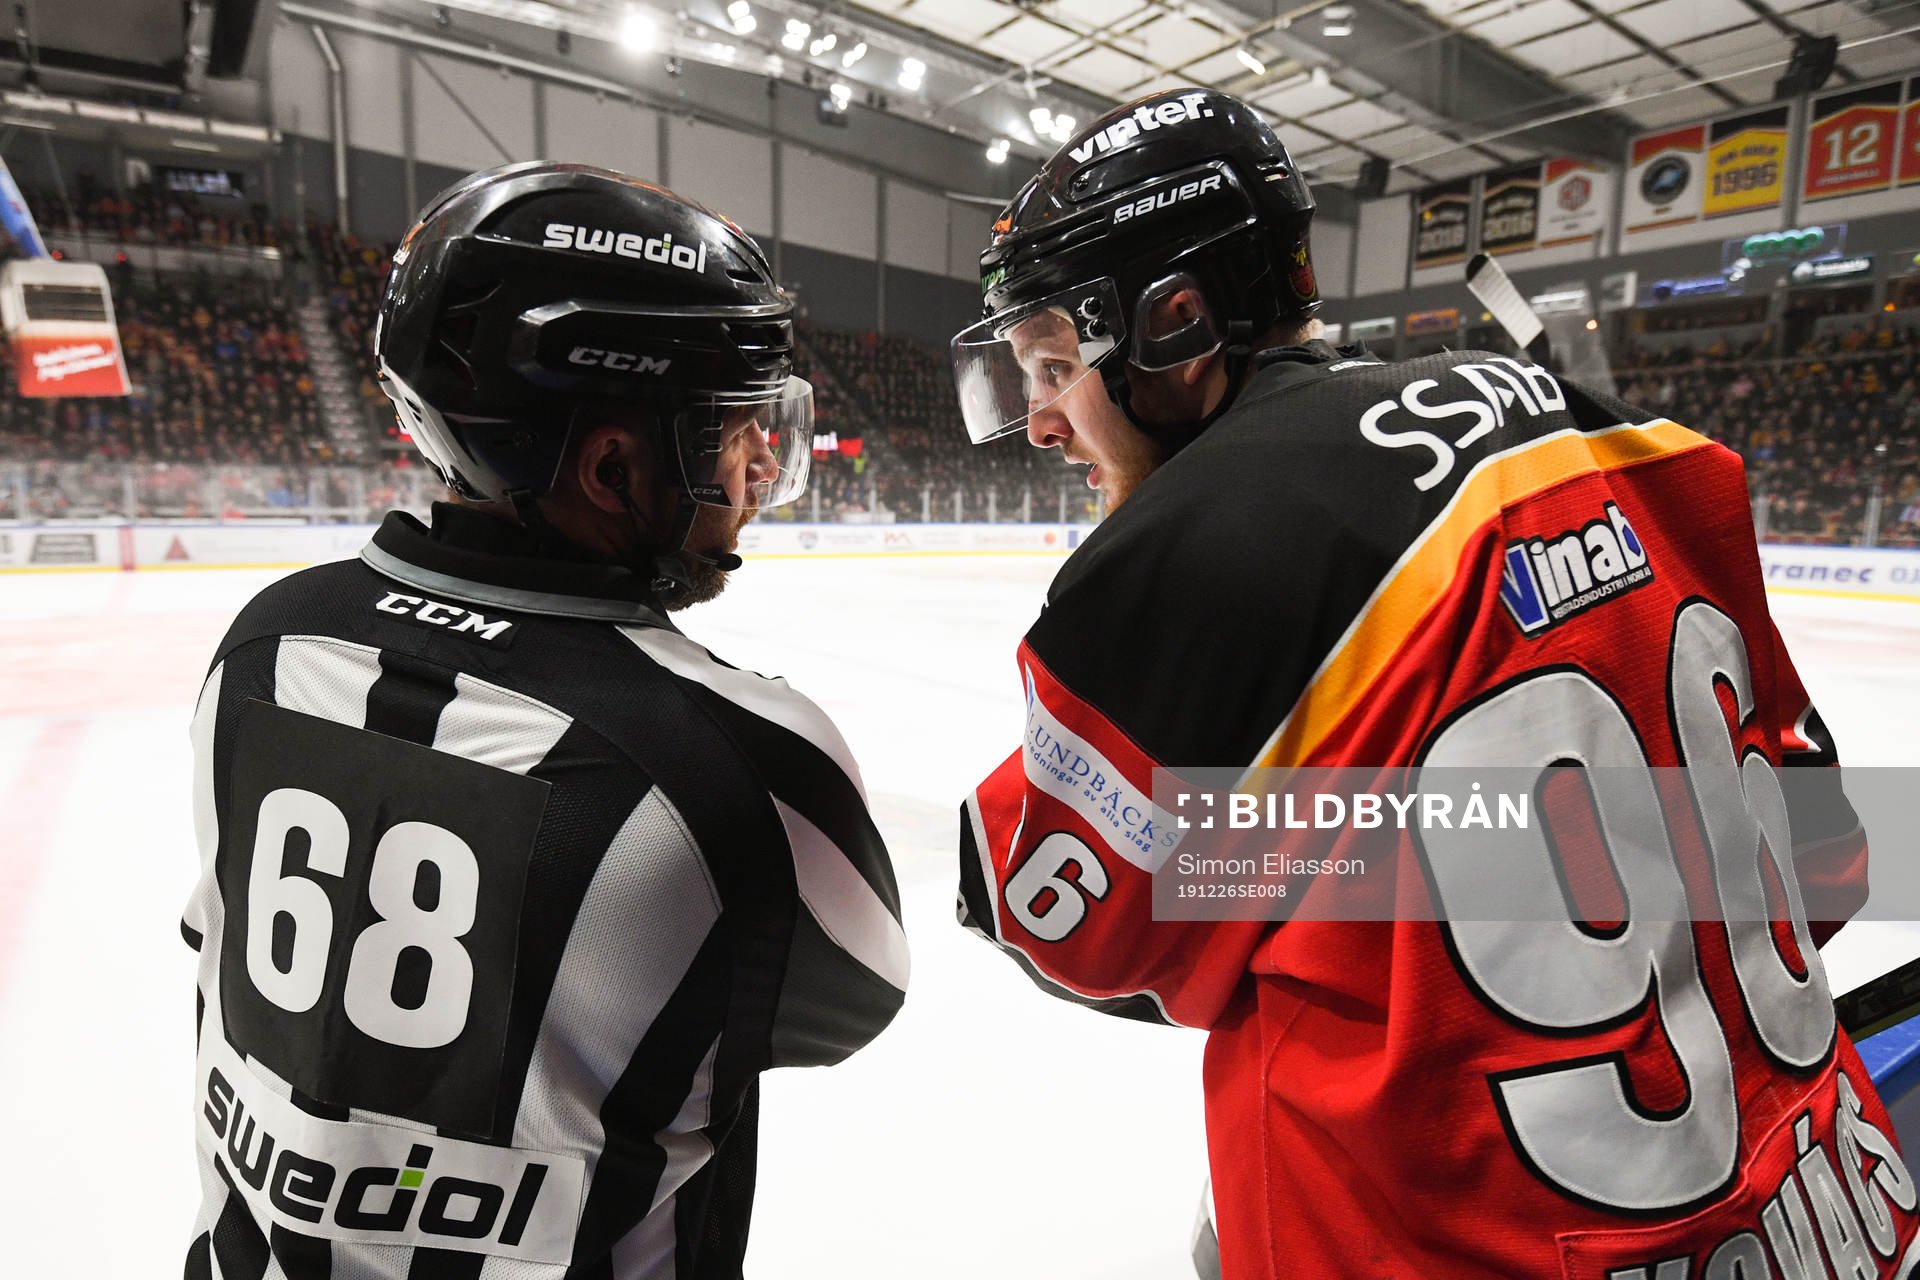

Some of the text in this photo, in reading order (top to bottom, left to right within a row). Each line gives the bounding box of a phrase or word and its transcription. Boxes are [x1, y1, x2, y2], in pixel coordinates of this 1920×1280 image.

[1068, 94, 1215, 164] vinter.
[1825, 120, 1881, 171] 12
[1113, 174, 1222, 225] BAUER
[543, 223, 707, 274] swedol
[567, 346, 672, 375] CCM
[1359, 357, 1567, 492] SSAB
[693, 487, 722, 496] CCM
[1500, 505, 1647, 633] Vinab
[1760, 558, 1874, 583] ranec
[376, 591, 513, 641] CCM
[1031, 713, 1179, 847] UNDBÄCKS
[1083, 789, 1097, 802] av
[1100, 806, 1120, 828] alla
[1124, 830, 1152, 853] slag
[246, 787, 480, 1049] 68
[1005, 832, 1111, 943] 6
[1414, 598, 1836, 1214] 96
[203, 1065, 550, 1247] swedol
[1610, 1071, 1917, 1280] VÁCS
